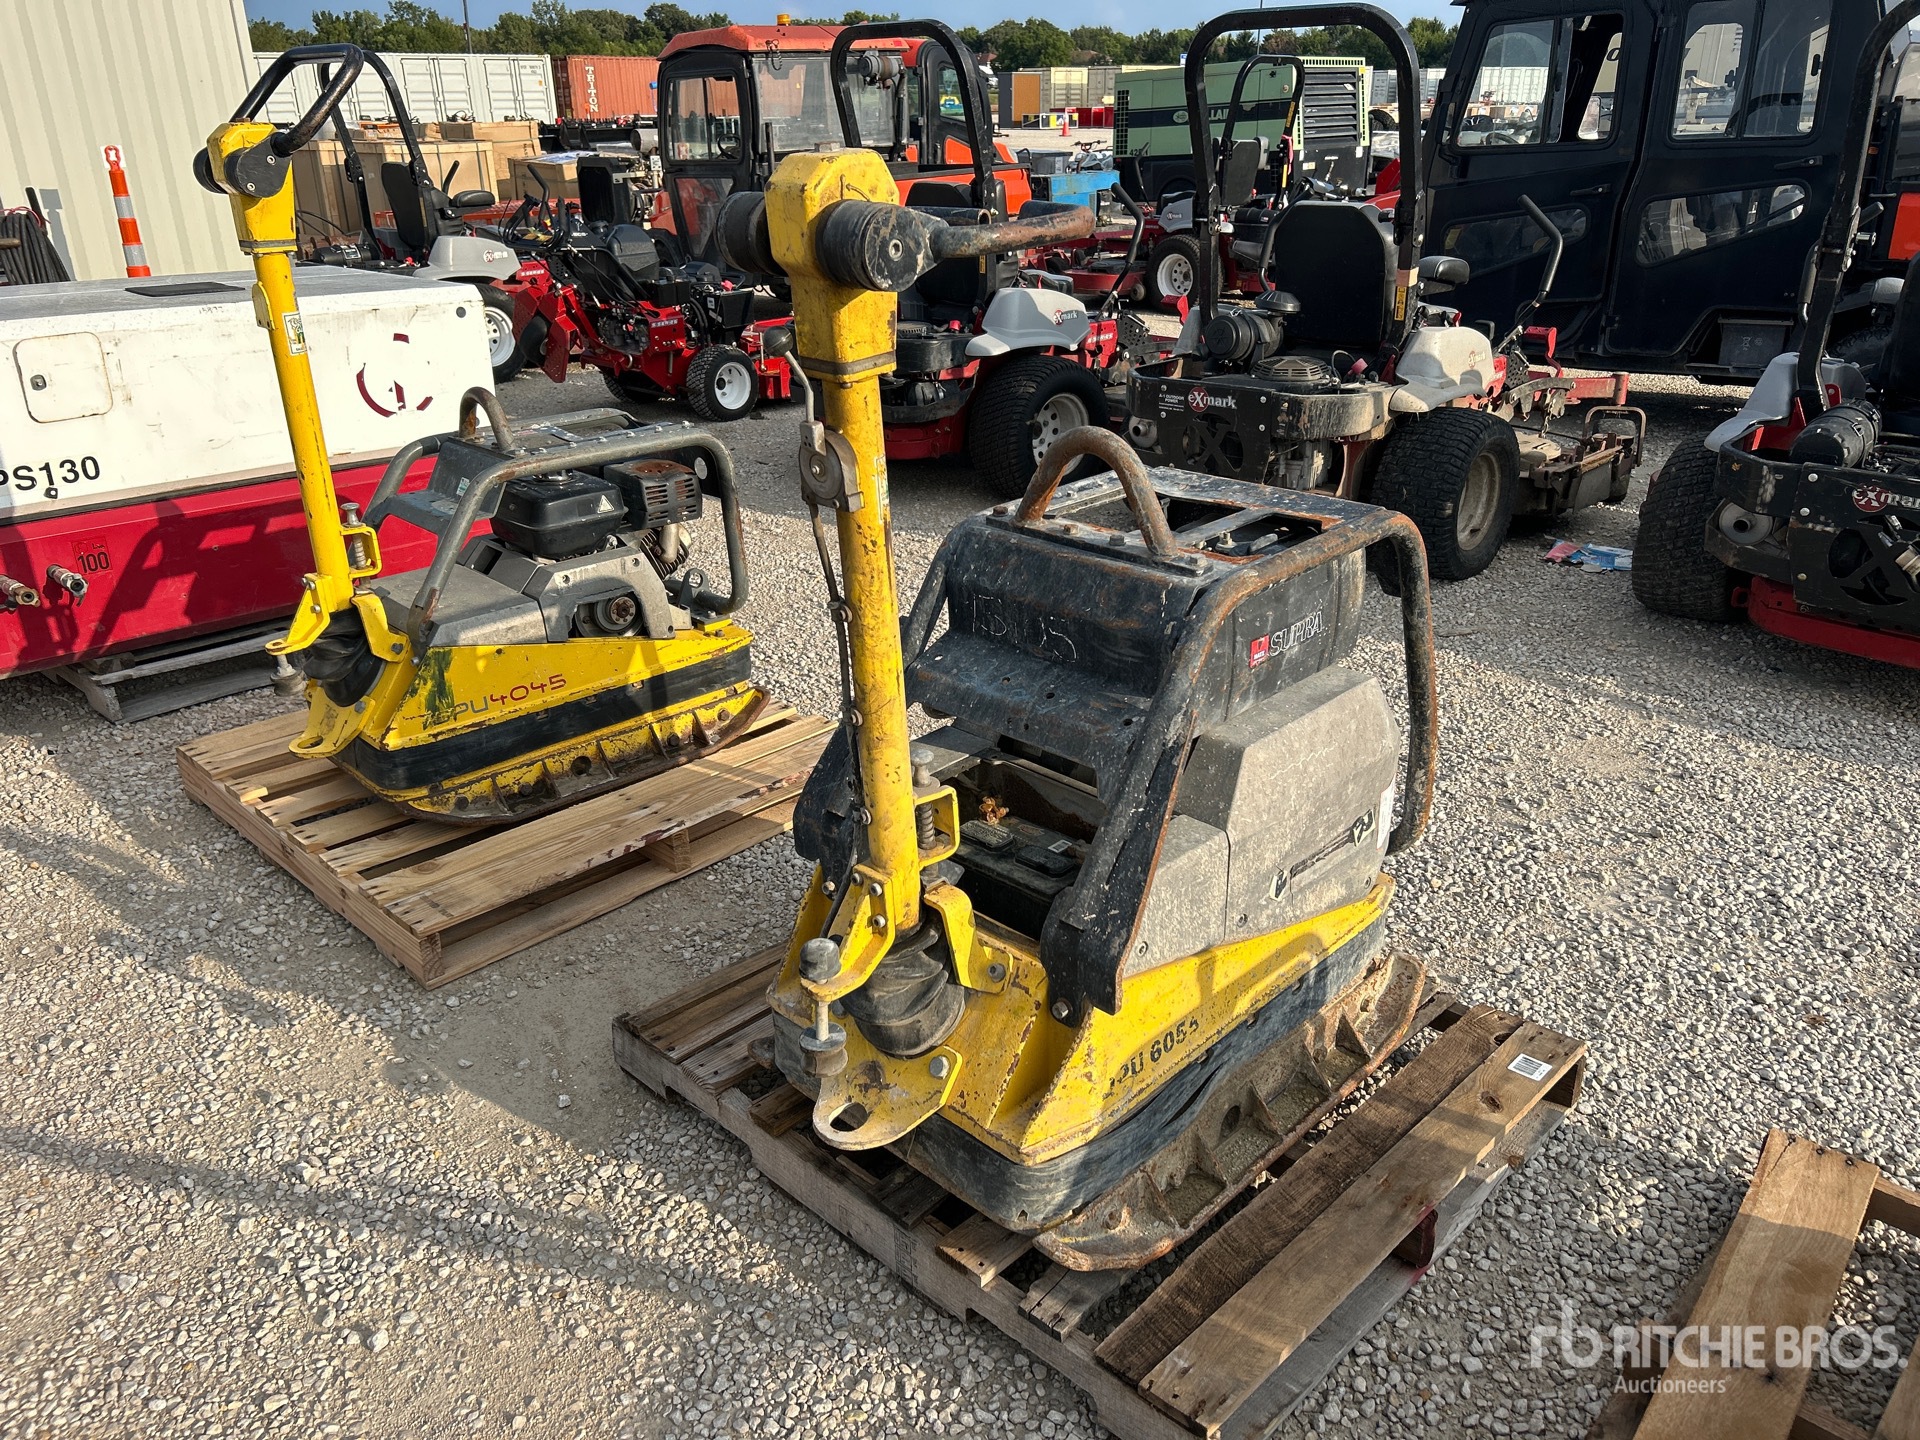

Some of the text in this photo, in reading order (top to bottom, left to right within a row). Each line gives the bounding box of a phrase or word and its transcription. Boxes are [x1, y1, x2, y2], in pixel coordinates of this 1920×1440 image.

[585, 66, 599, 113] TRITON
[1188, 391, 1237, 410] eXmark
[77, 552, 110, 574] 100
[1270, 611, 1324, 657] SUPRA
